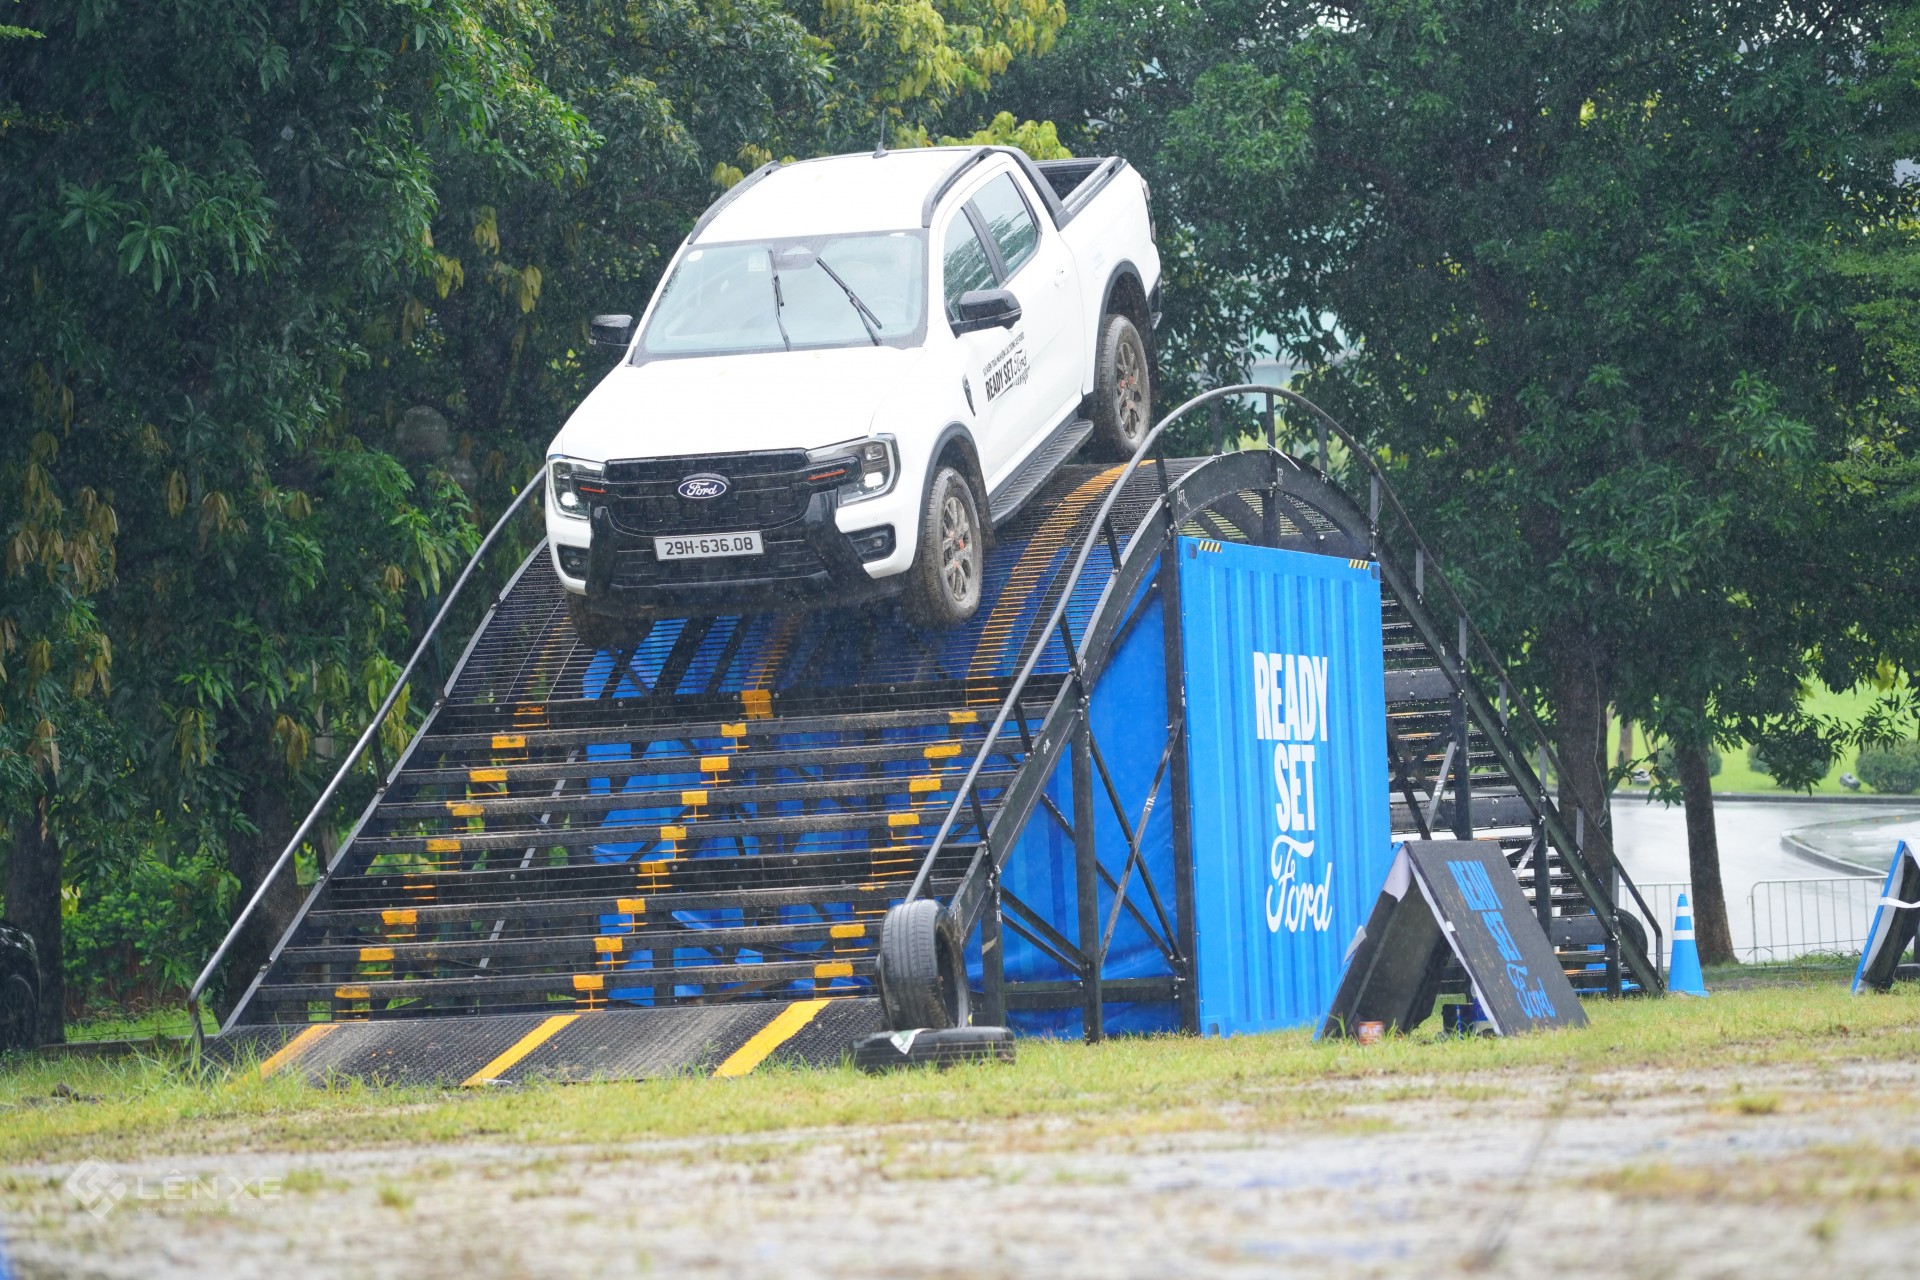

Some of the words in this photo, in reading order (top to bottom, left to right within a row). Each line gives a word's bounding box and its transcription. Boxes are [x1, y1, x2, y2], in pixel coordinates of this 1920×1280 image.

[985, 367, 1004, 402] READY
[1003, 358, 1014, 385] SET
[686, 481, 718, 496] Ford
[664, 536, 754, 556] 29H-636.08
[1253, 651, 1328, 742] READY
[1273, 742, 1316, 833] SET
[1266, 834, 1333, 933] Ford
[1446, 860, 1504, 911] READY
[1482, 911, 1523, 962] SET
[1506, 962, 1556, 1019] Ford
